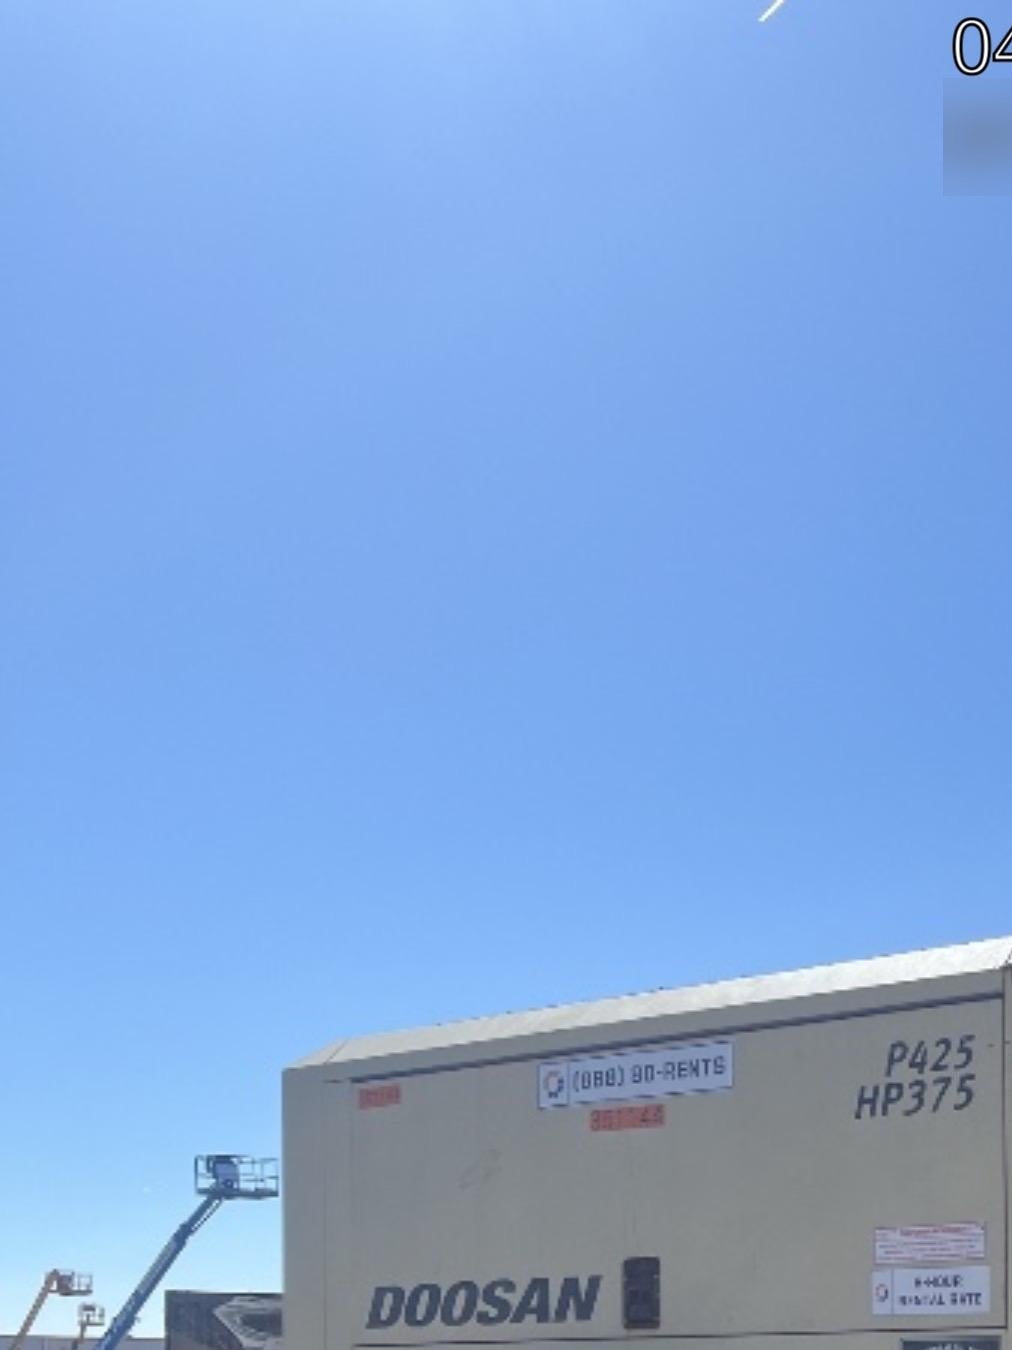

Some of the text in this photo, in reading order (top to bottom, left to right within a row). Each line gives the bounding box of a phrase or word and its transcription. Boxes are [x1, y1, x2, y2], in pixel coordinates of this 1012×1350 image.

[885, 1034, 976, 1077] P425
[854, 1074, 976, 1120] HP375
[365, 1274, 603, 1329] DOOSAN
